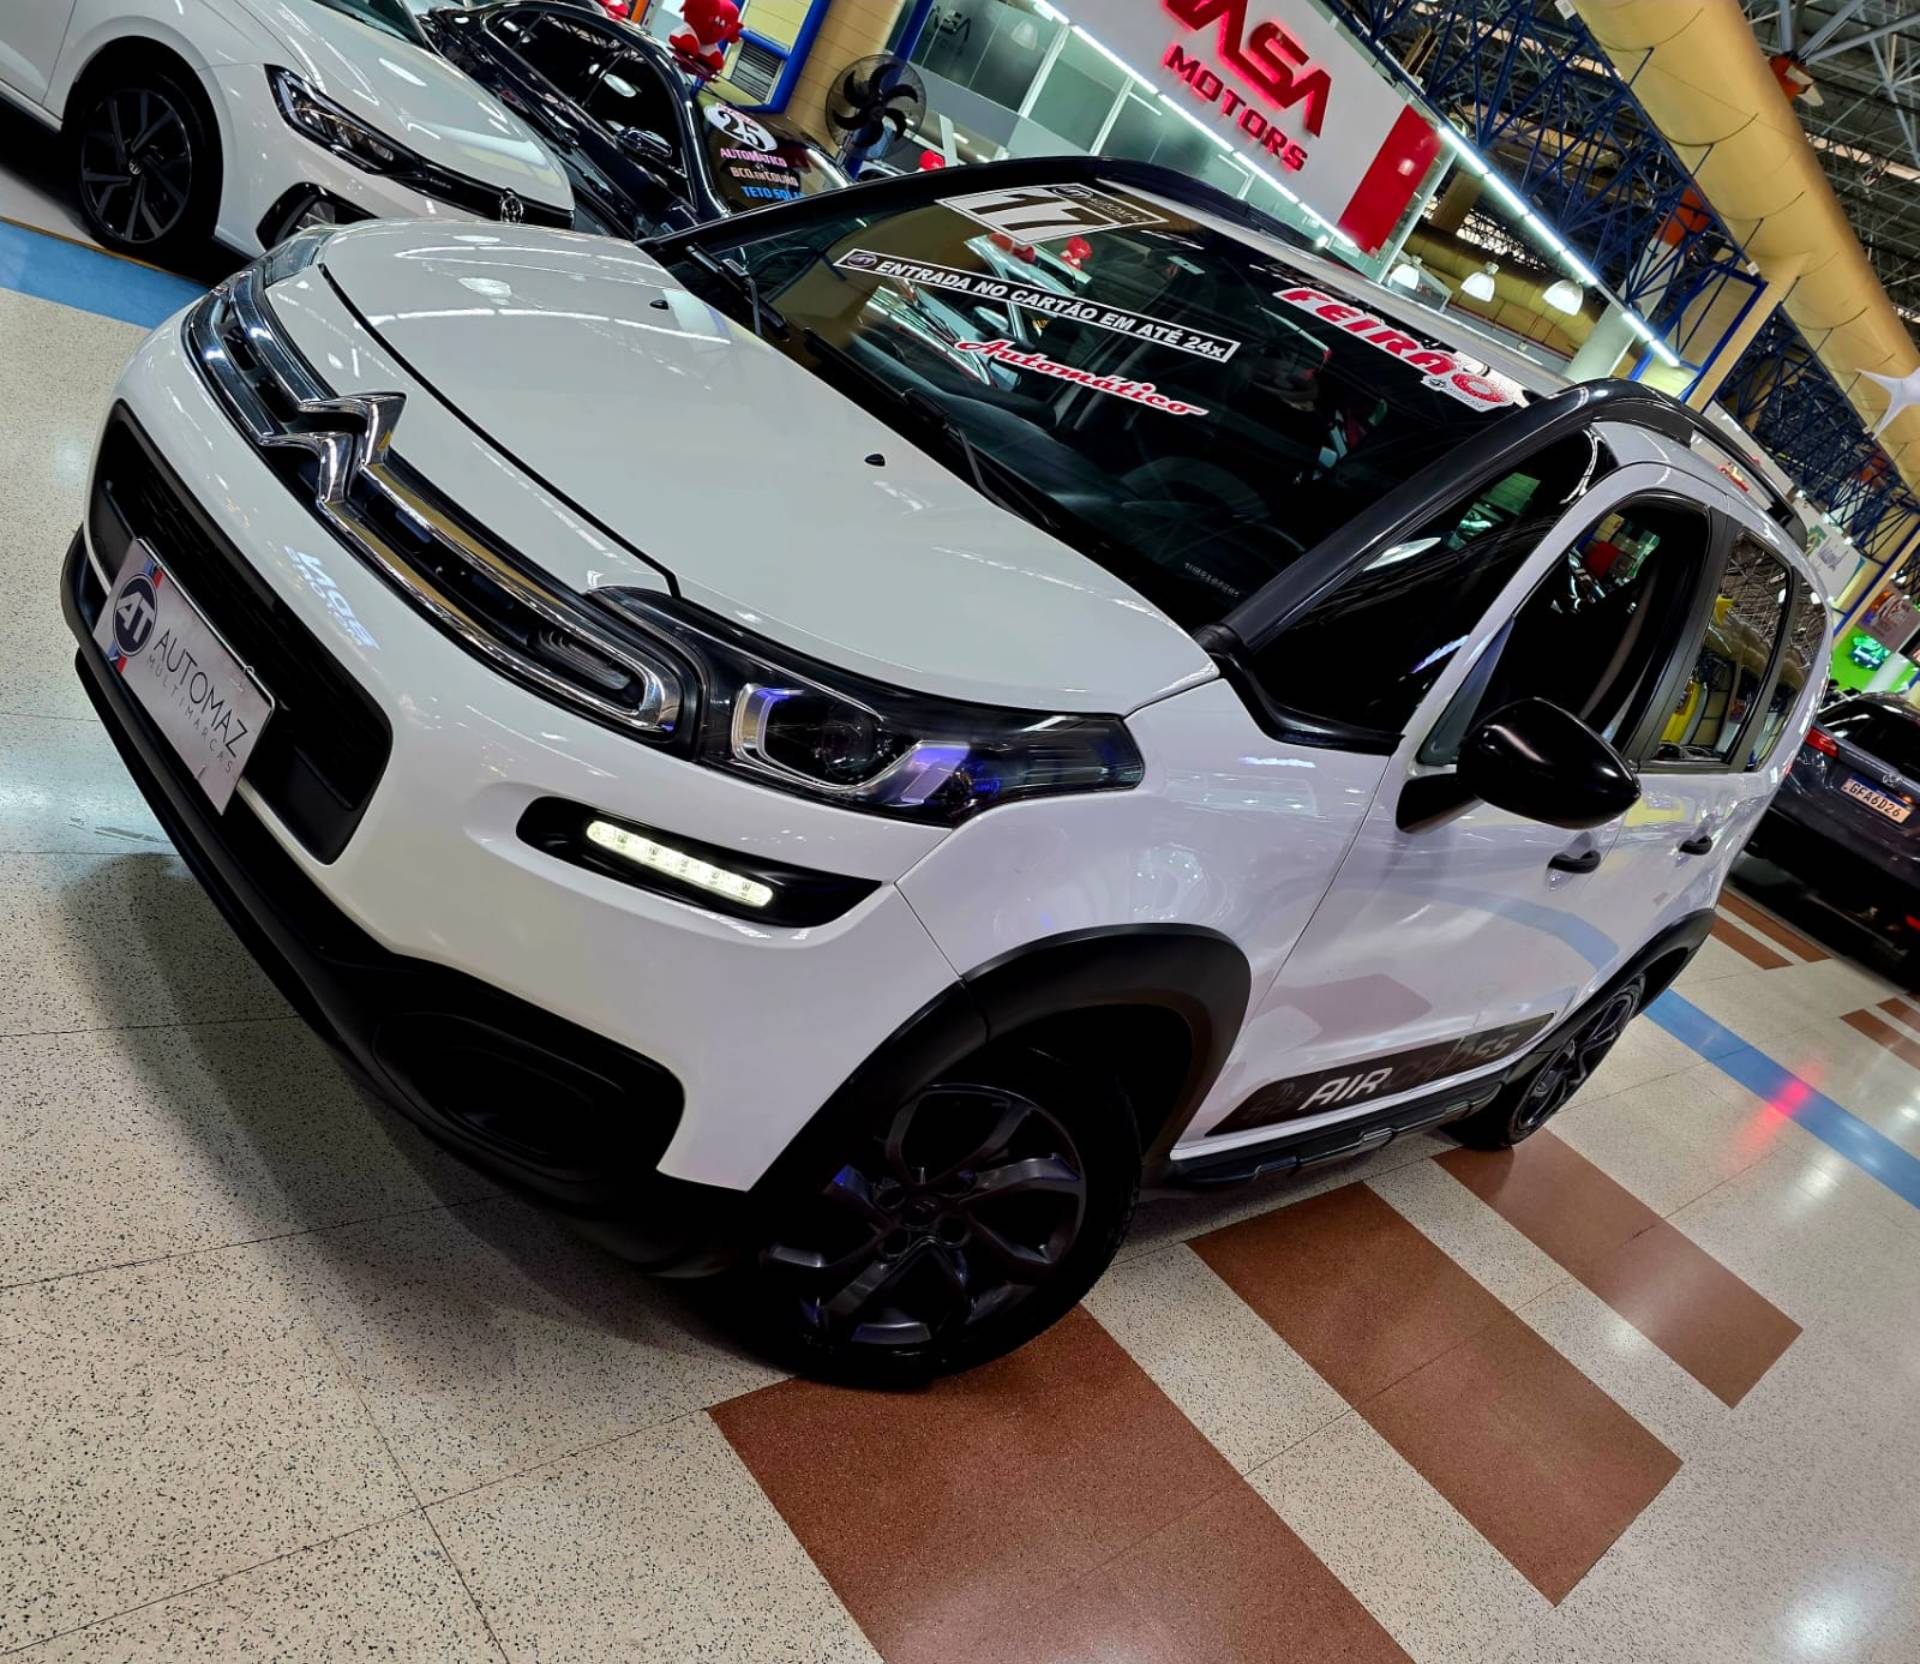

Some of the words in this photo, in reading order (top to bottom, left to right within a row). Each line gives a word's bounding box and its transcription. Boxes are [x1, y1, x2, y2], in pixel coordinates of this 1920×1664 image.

[1164, 0, 1332, 138] ASA
[1164, 45, 1309, 172] MOTORS
[718, 109, 767, 151] 25
[740, 186, 773, 198] TETO
[875, 261, 969, 290] ENTRADA
[973, 282, 1009, 297] NO
[1010, 288, 1098, 320] CARTÃO
[1099, 312, 1137, 331] EM
[1136, 324, 1184, 345] ATÉ
[1182, 336, 1227, 358] 24x
[955, 338, 1208, 416] Automático
[147, 656, 233, 773] MULTIMARCAS
[153, 628, 249, 758] AUTOMAZ
[1849, 783, 1902, 817] GFA6D26
